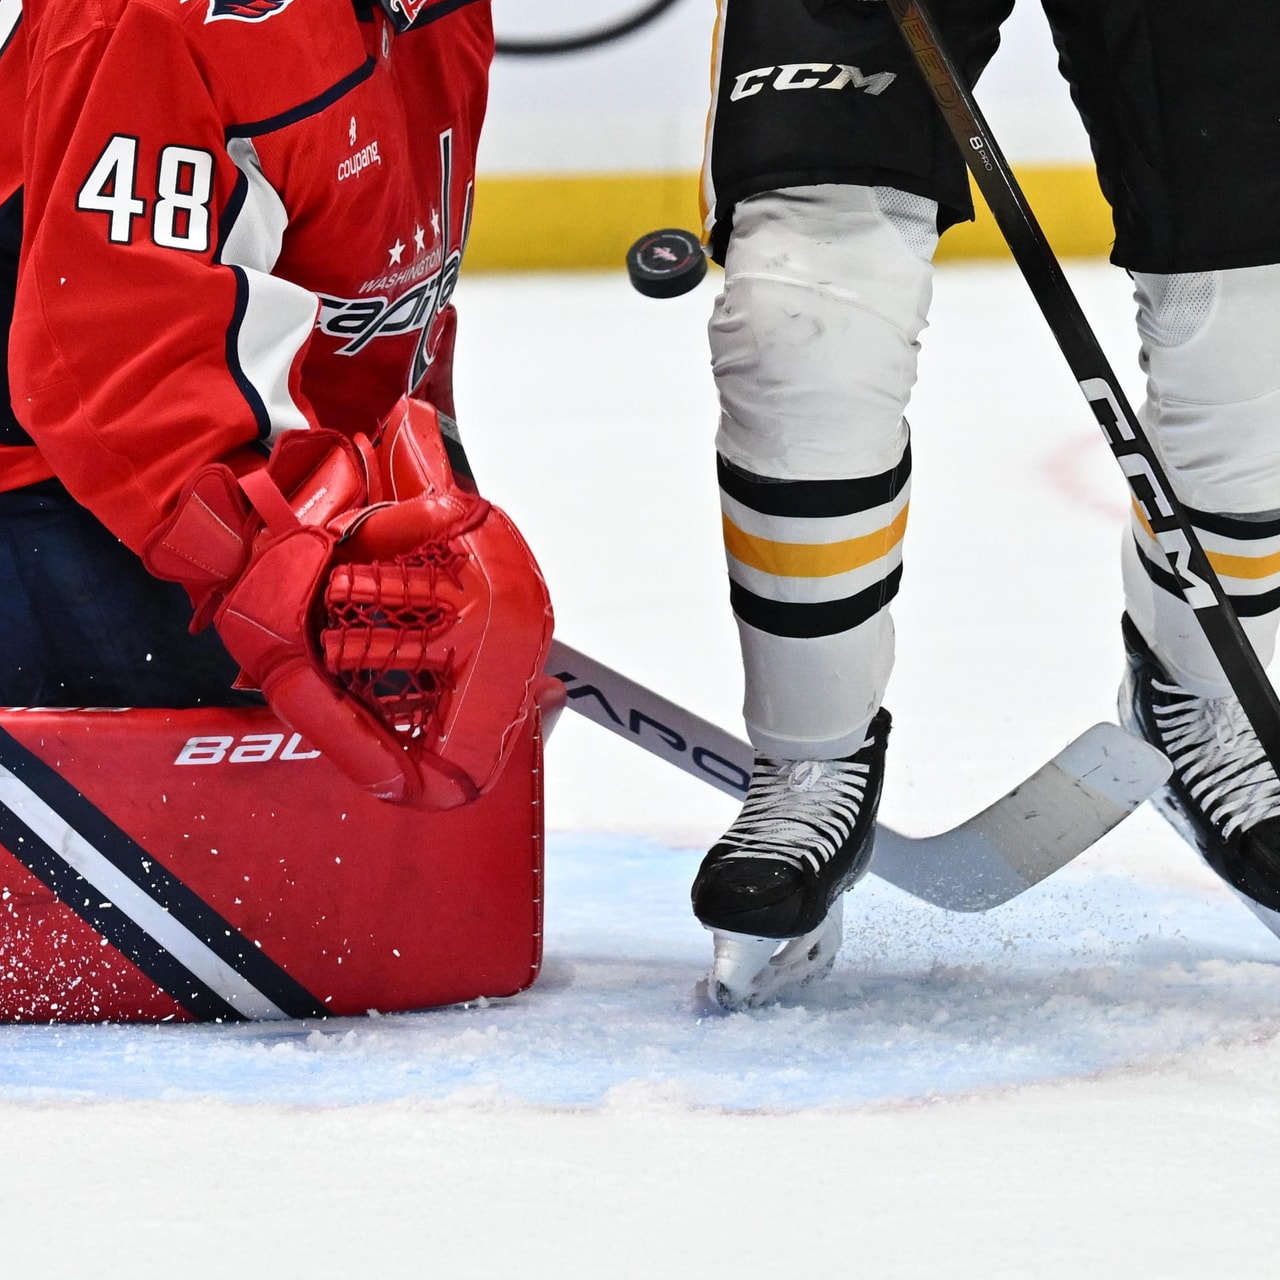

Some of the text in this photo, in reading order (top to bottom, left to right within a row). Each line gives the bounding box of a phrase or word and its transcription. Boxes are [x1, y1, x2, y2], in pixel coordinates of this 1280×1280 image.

[730, 63, 898, 103] CCM
[76, 132, 216, 253] 48
[337, 140, 382, 182] coupang
[1078, 376, 1220, 610] CCM
